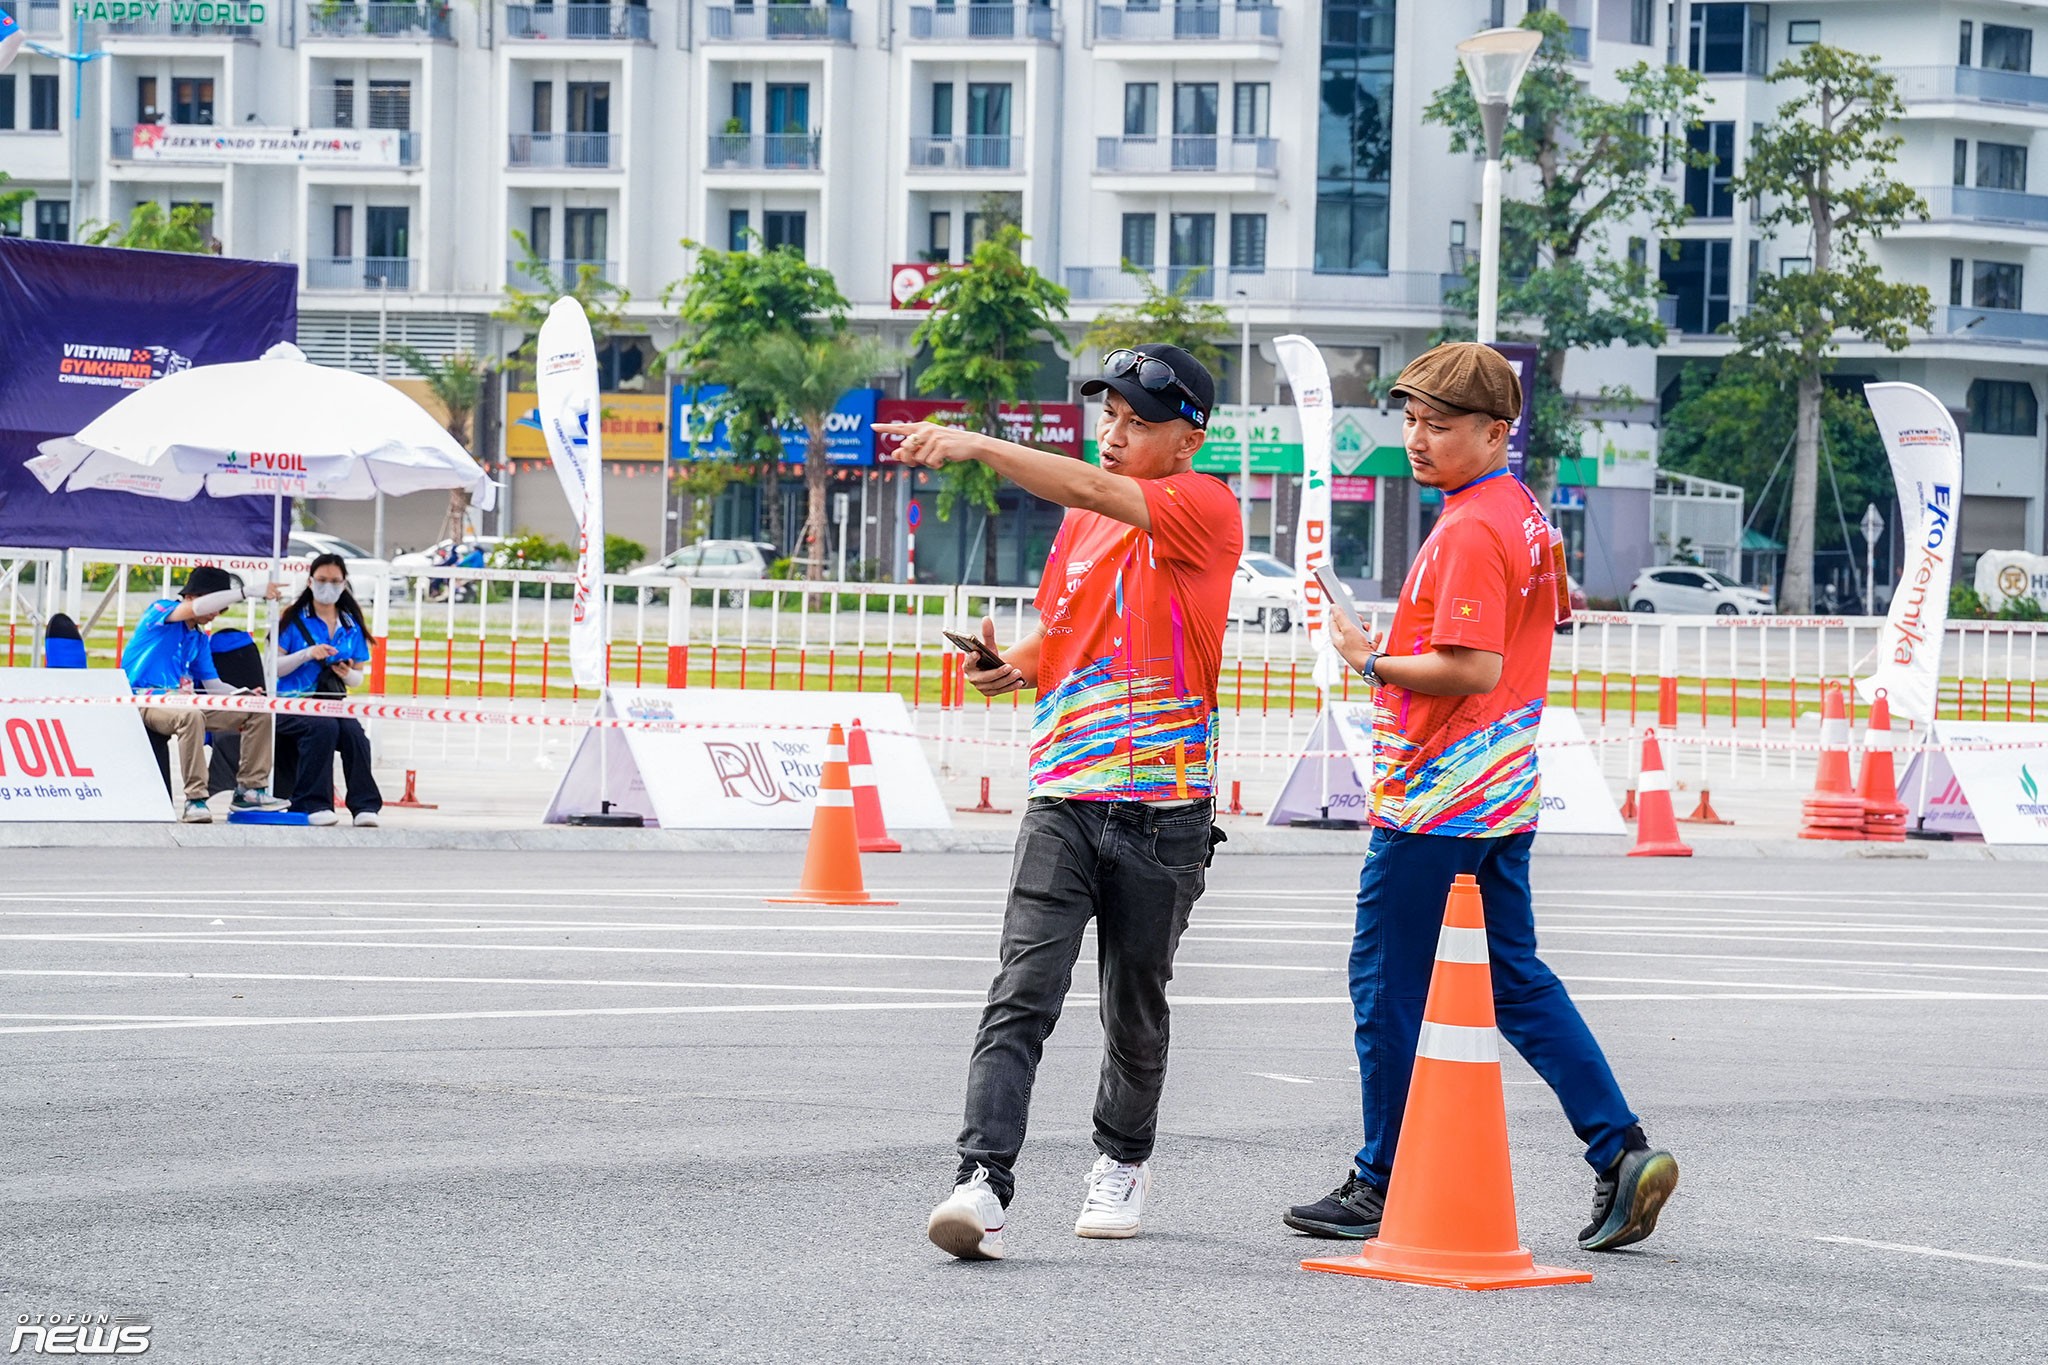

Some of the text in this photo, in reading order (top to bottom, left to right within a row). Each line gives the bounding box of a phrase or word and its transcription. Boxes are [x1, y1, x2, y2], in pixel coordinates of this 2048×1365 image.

[73, 2, 265, 23] HAPPY WORLD
[260, 137, 309, 150] THANH
[63, 343, 132, 362] VIETNAM
[60, 357, 152, 378] GYMKHANA
[58, 374, 122, 388] CHAMPIONSHIP
[1271, 427, 1280, 440] 2
[250, 451, 307, 471] PVOIL
[230, 559, 268, 571] GIAO
[772, 741, 810, 757] Ngọc
[13, 787, 32, 798] xa
[34, 785, 72, 798] thêm
[75, 782, 103, 800] gần
